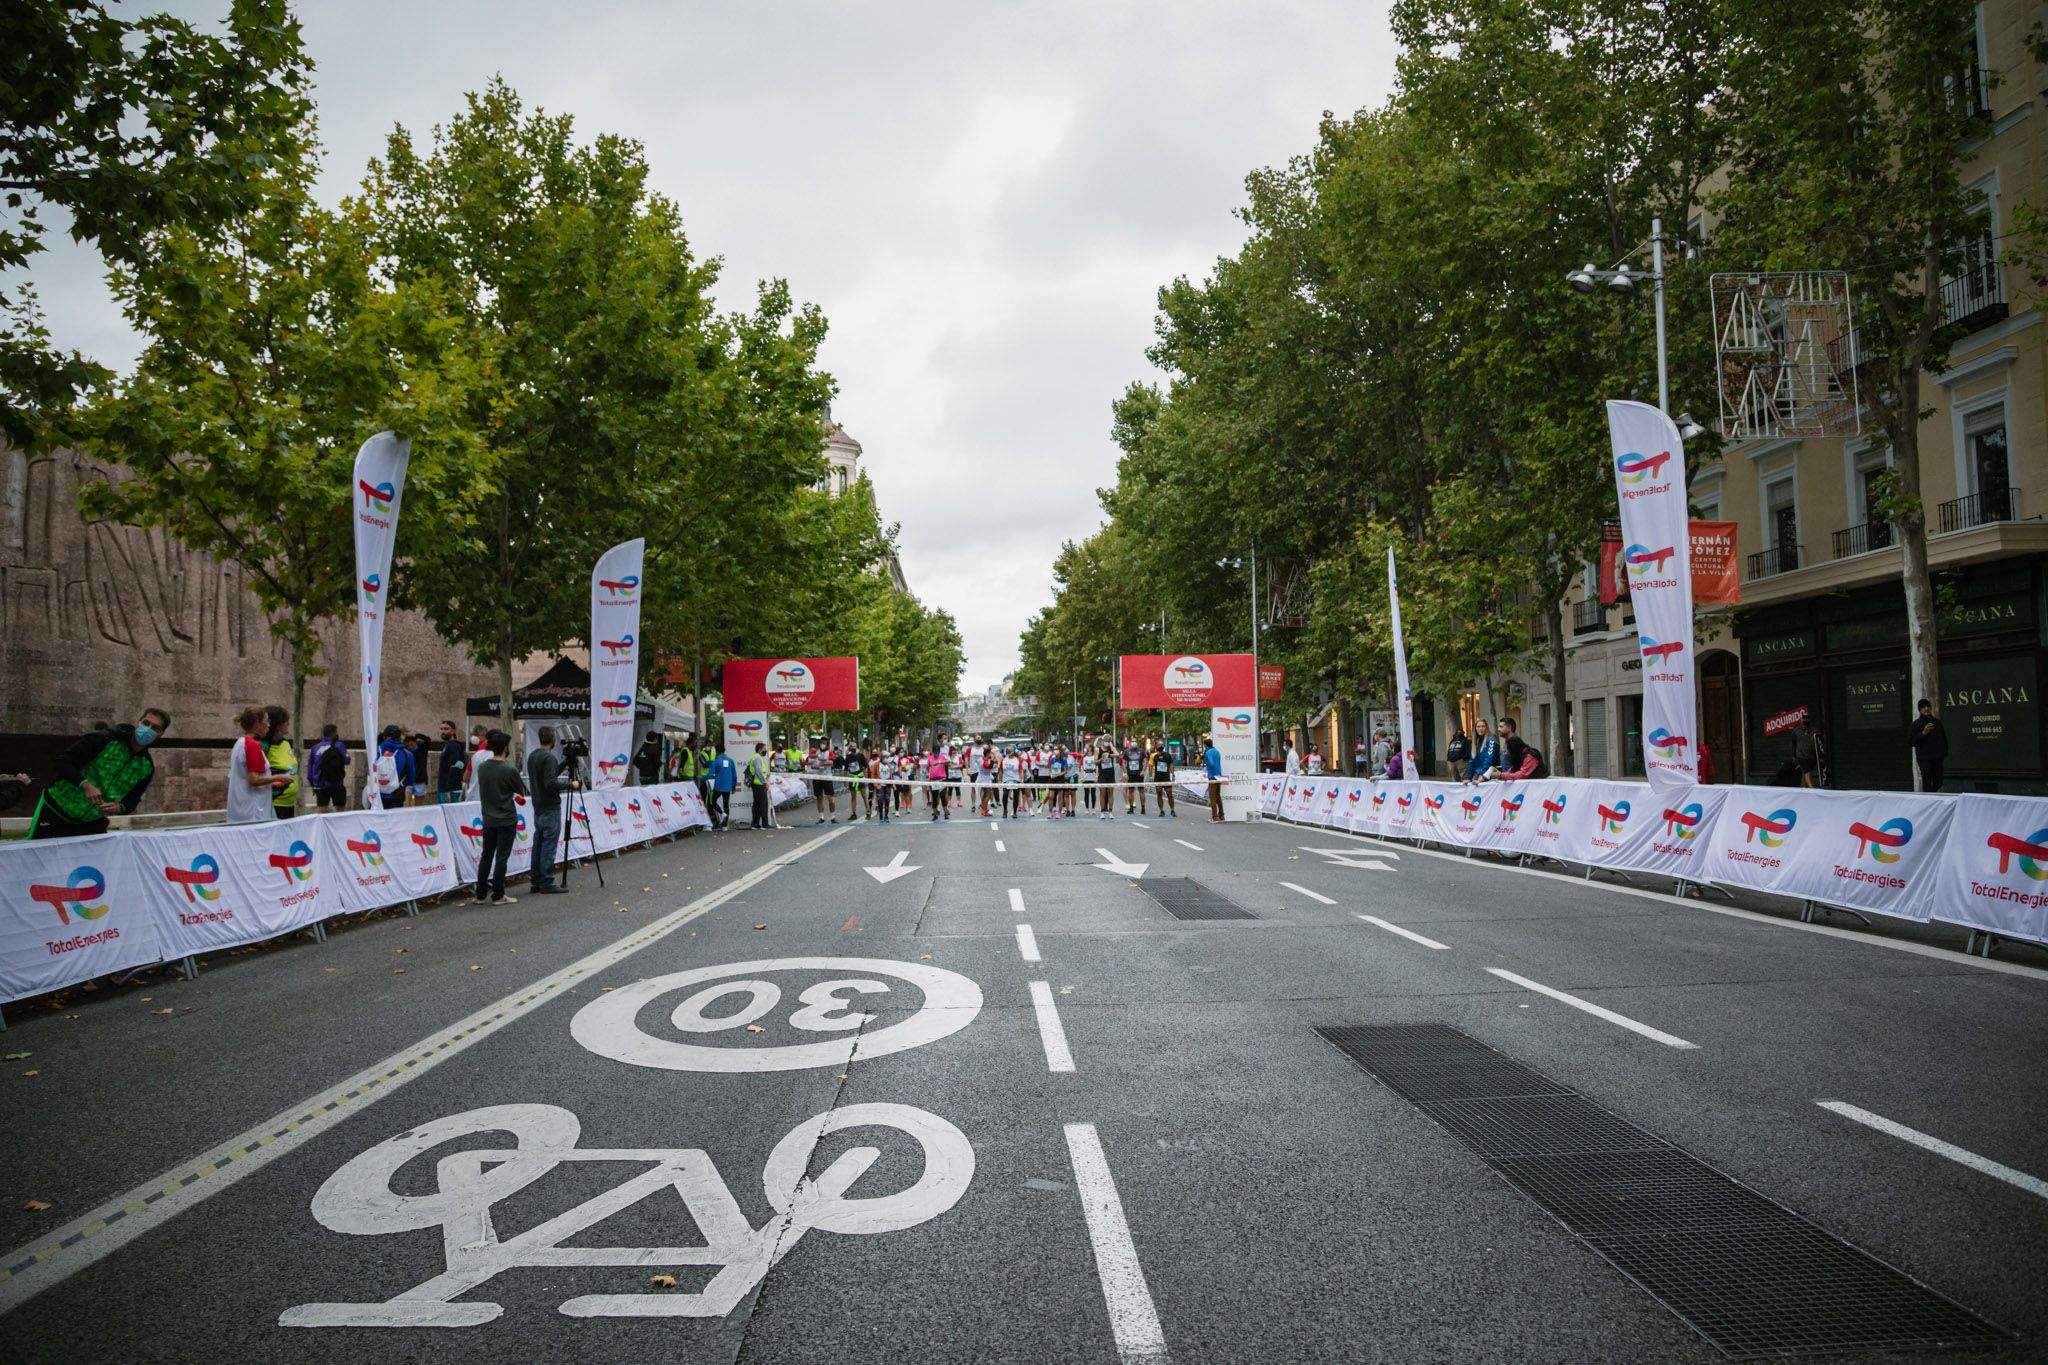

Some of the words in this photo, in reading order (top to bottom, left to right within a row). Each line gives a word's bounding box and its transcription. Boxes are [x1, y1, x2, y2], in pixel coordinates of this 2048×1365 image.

[1690, 534, 1731, 545] ERNÁN
[1953, 603, 2016, 624] SCANA
[1756, 637, 1806, 655] ASCANA
[1849, 682, 1897, 696] ASCANA
[1945, 687, 2029, 708] ASCANA
[1766, 709, 1808, 732] ADQUIRIDO
[1972, 714, 2001, 723] ADQUIRIDO
[1727, 849, 1782, 869] TotalEnergies
[1833, 864, 1907, 889] TotalEnergies
[1971, 881, 2048, 909] TotalEnergie
[670, 979, 892, 1033] 30
